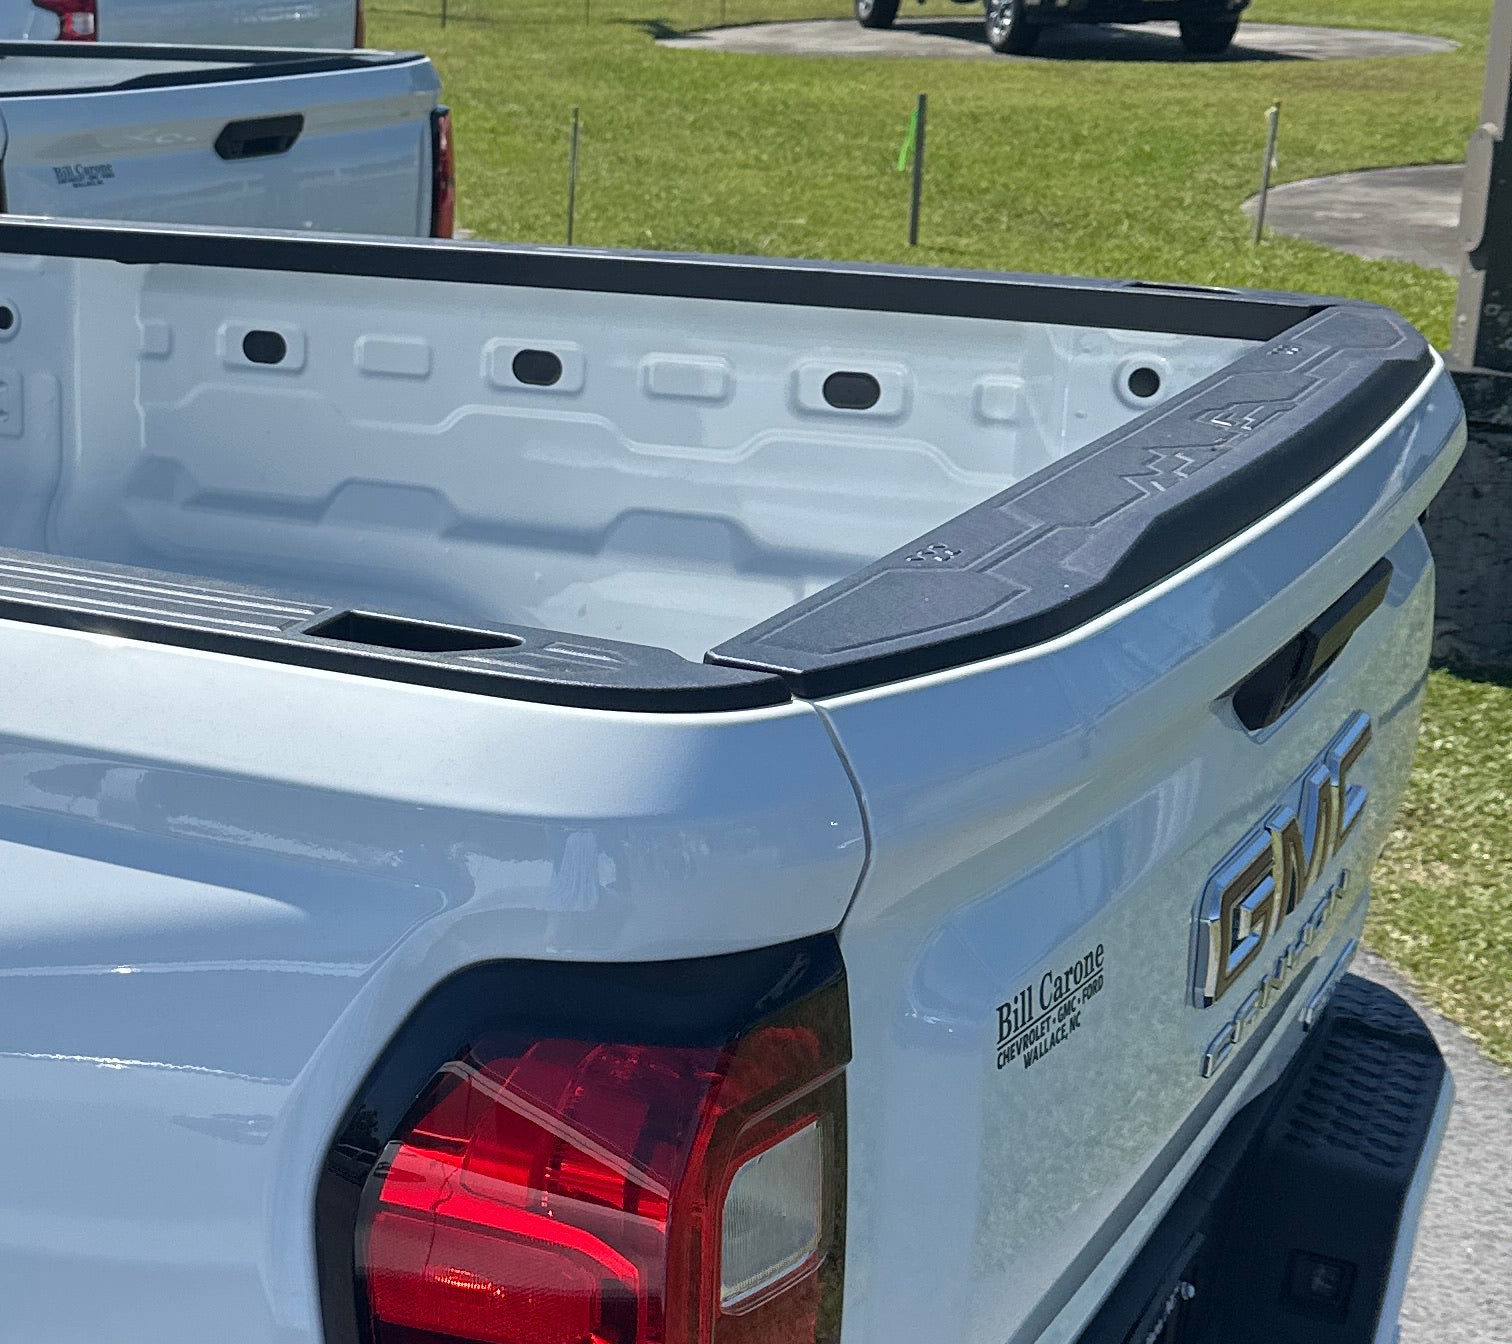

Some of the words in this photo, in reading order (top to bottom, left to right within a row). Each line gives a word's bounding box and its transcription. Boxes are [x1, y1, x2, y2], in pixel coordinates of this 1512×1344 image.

[1190, 709, 1373, 1009] GMC
[996, 984, 1034, 1045] Bill
[1039, 943, 1104, 1011] Carone
[996, 1015, 1052, 1070] CHEVROLET
[1057, 995, 1076, 1023] GMC
[1082, 974, 1104, 1005] FORD
[1023, 1022, 1068, 1069] WALLACE,
[1069, 1010, 1081, 1034] NC
